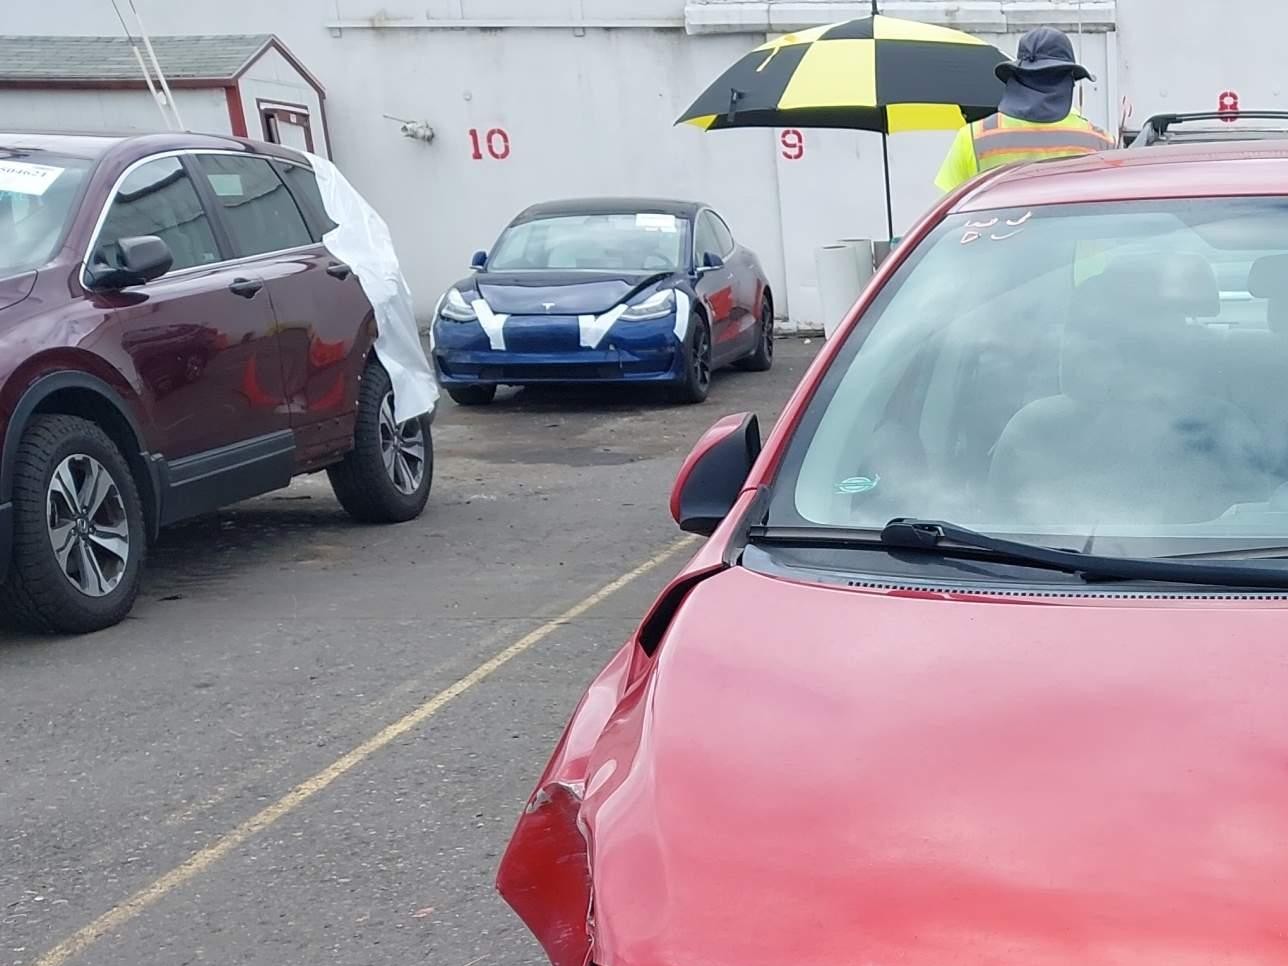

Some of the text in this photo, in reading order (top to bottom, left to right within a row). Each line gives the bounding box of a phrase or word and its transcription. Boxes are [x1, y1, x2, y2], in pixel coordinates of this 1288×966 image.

[1217, 91, 1240, 123] 8
[469, 129, 510, 160] 10
[781, 129, 804, 160] 9
